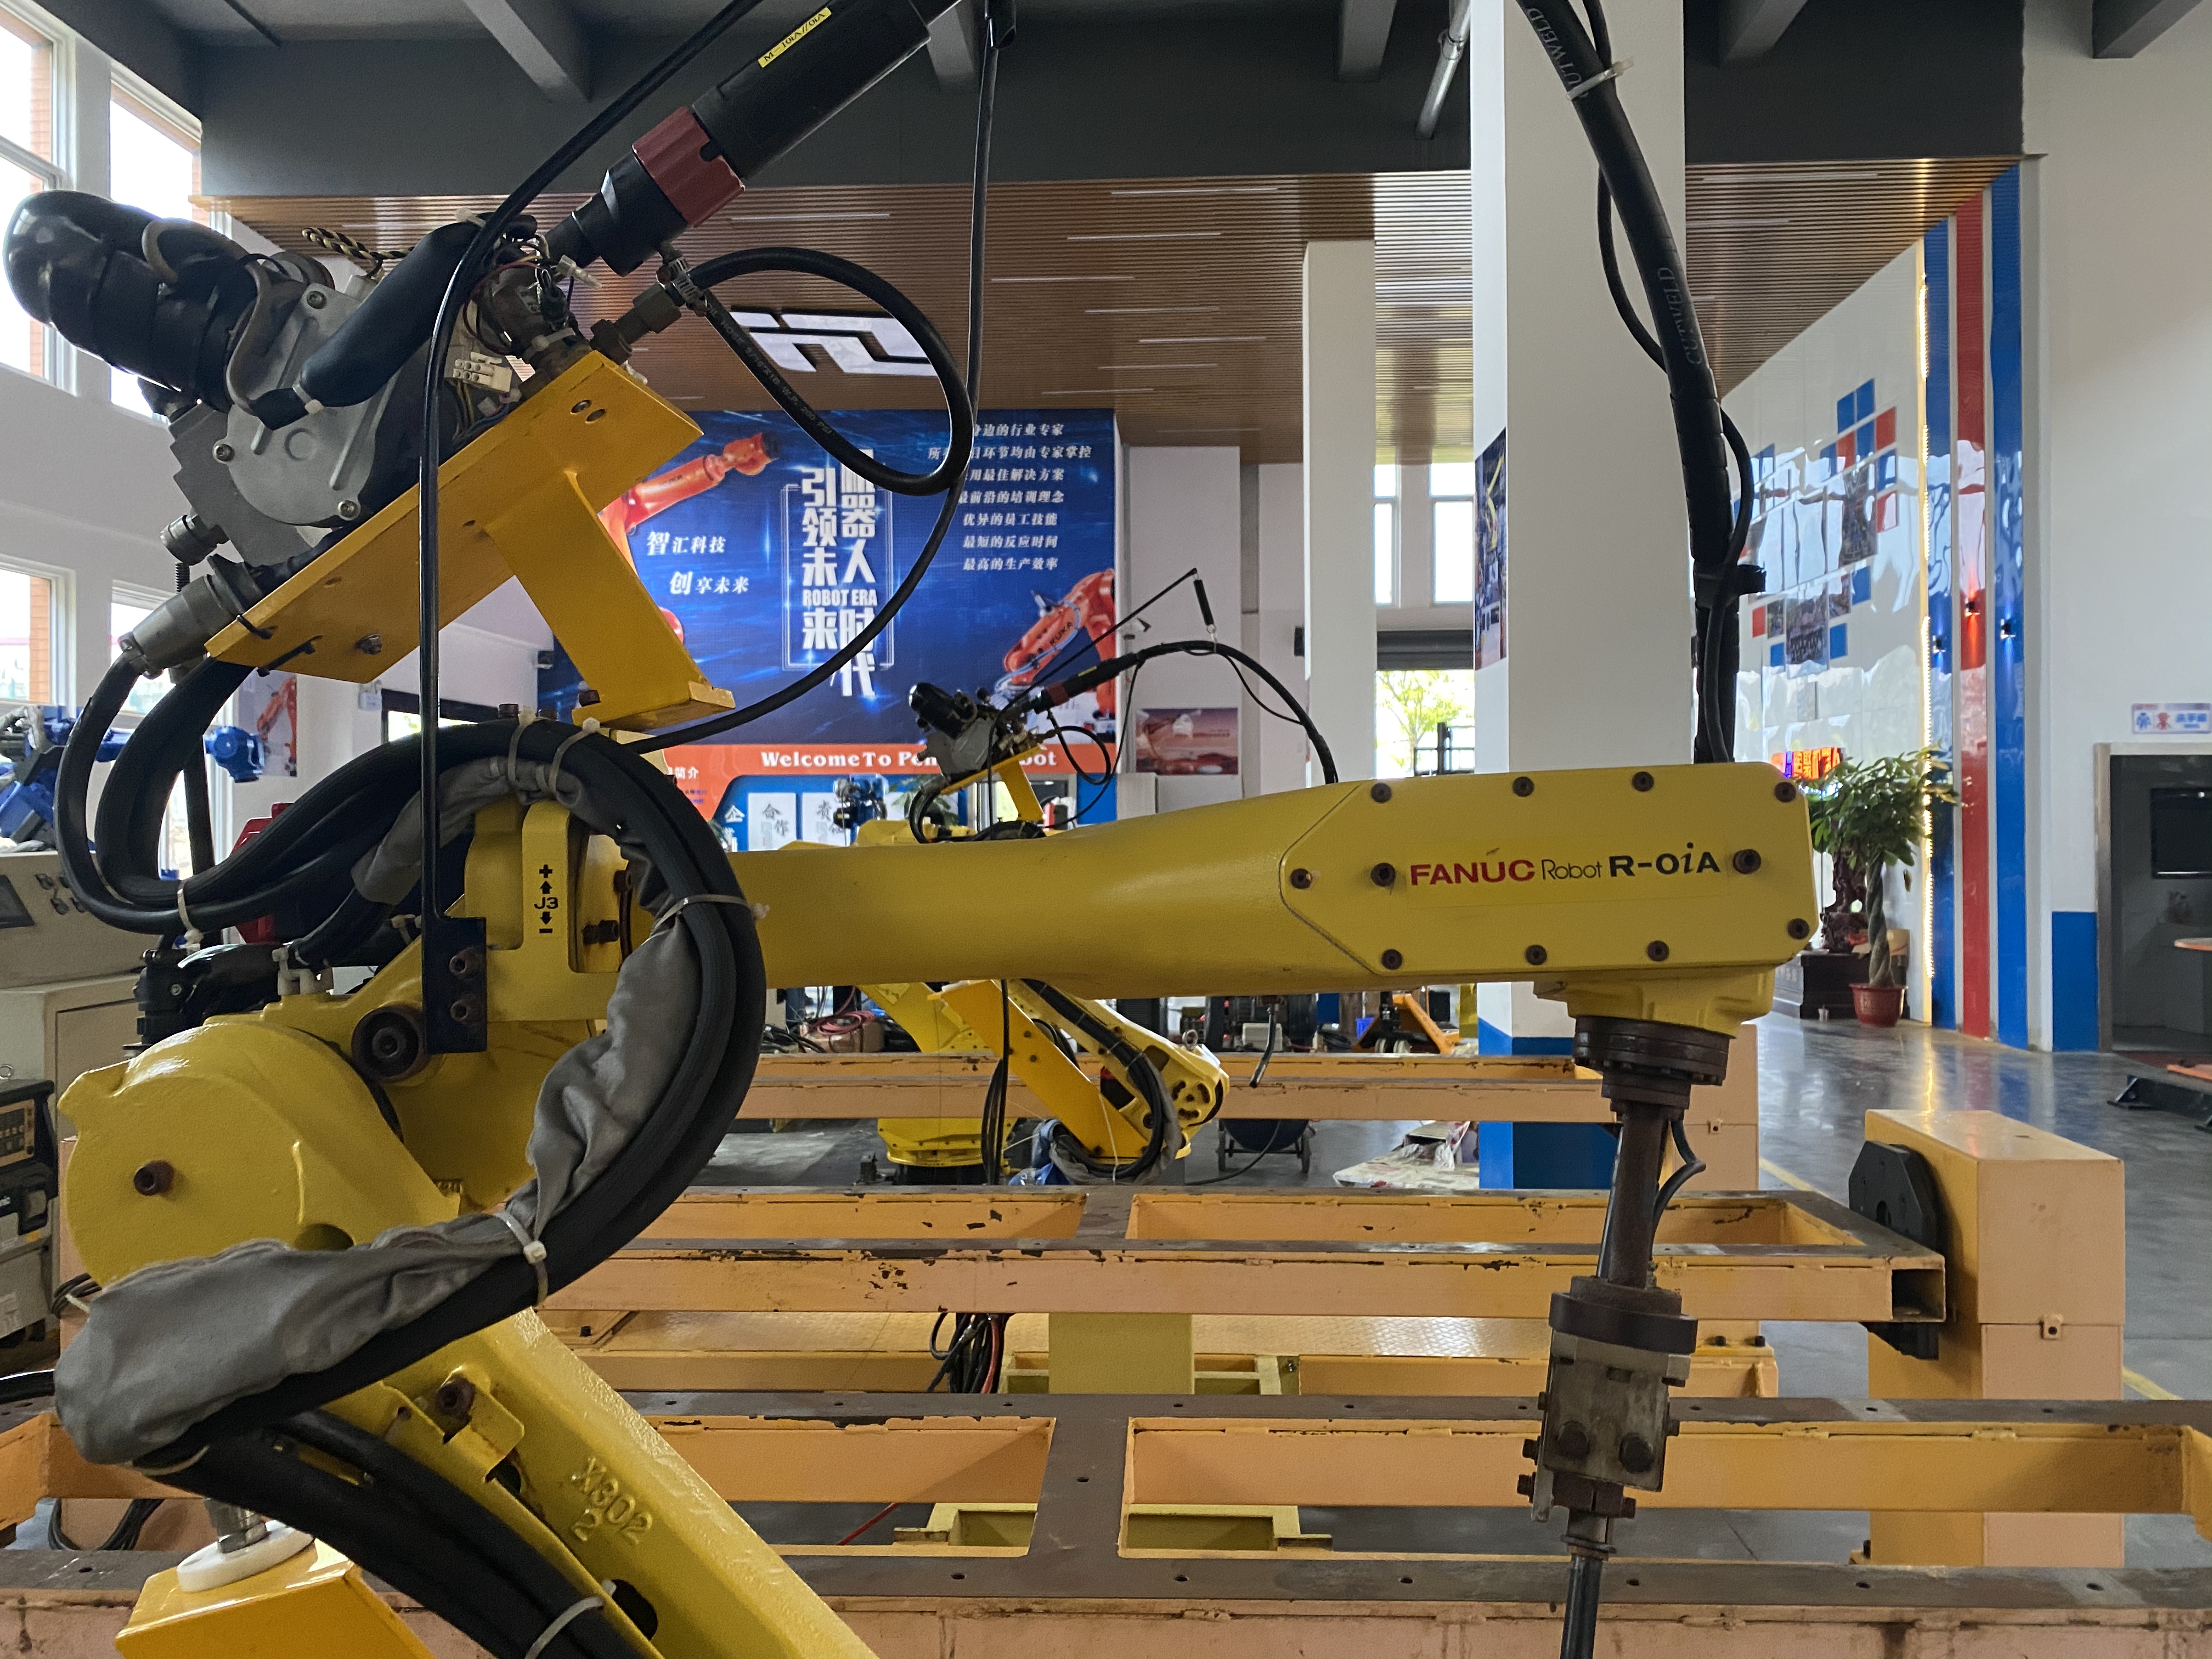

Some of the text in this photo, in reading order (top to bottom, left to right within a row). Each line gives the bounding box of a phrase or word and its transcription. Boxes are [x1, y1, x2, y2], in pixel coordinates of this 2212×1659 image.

[1526, 8, 1589, 98] UTWELD
[928, 445, 1092, 460] 所目环节均由专家掌控
[966, 468, 1064, 482] 用最佳解决方案
[963, 512, 1058, 527] 优异的员工技能
[647, 531, 726, 556] 智汇科技
[963, 535, 1058, 549] 最短的反应时间
[963, 557, 1059, 571] 最高的生产效率
[669, 571, 749, 595] 创享未来
[803, 588, 878, 607] ROBOT ERA
[1410, 859, 1536, 886] FANUC
[1541, 859, 1603, 881] Robot
[534, 896, 558, 910] J3
